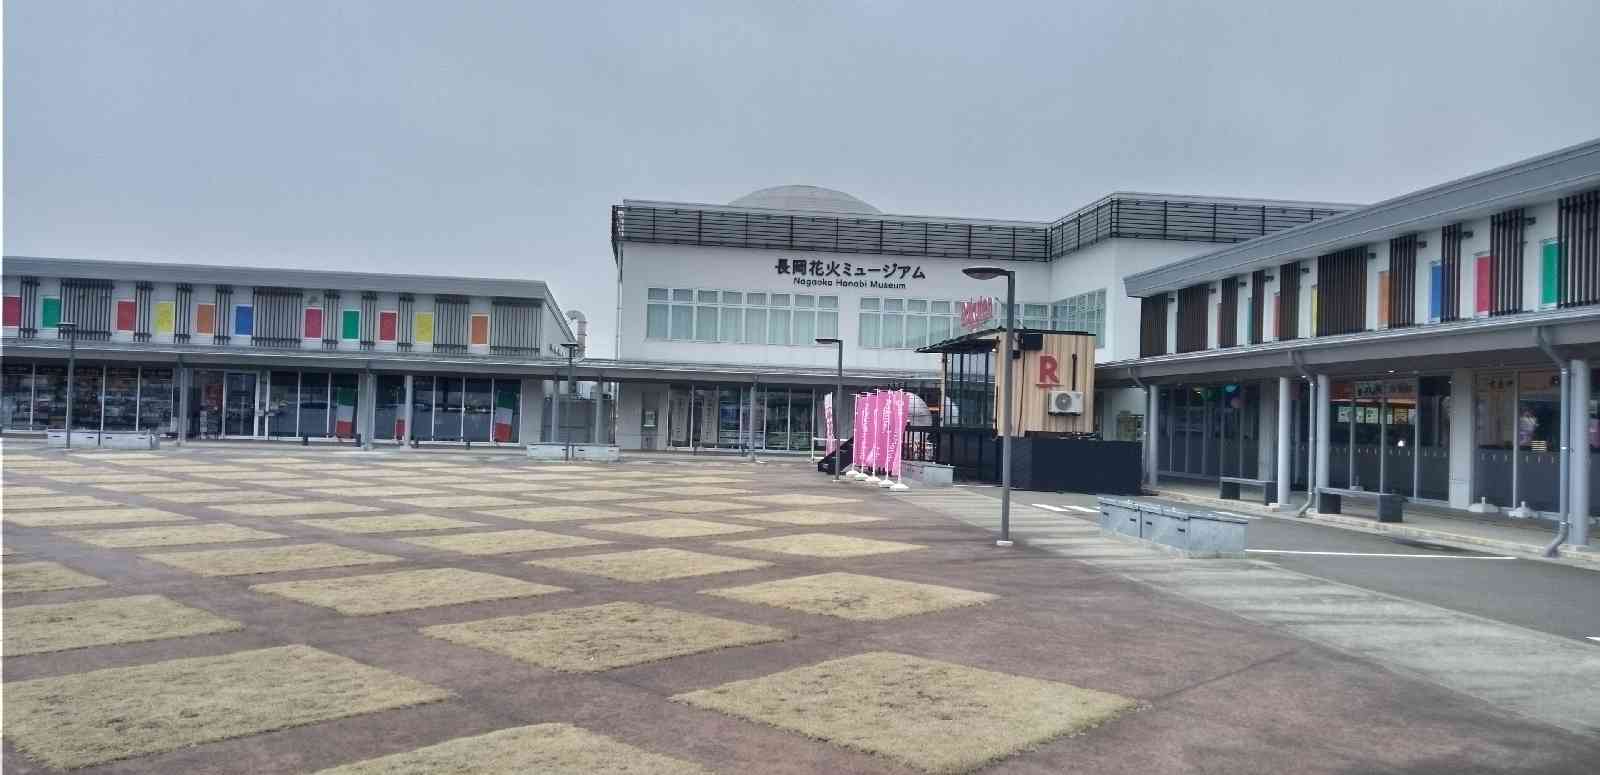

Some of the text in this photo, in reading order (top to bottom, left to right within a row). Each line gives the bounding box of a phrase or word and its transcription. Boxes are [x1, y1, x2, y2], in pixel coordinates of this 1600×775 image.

[775, 258, 926, 279] 長岡花火ミュージアム
[793, 277, 906, 290] Nagaoka Hanabi Museum
[1039, 356, 1060, 384] R
